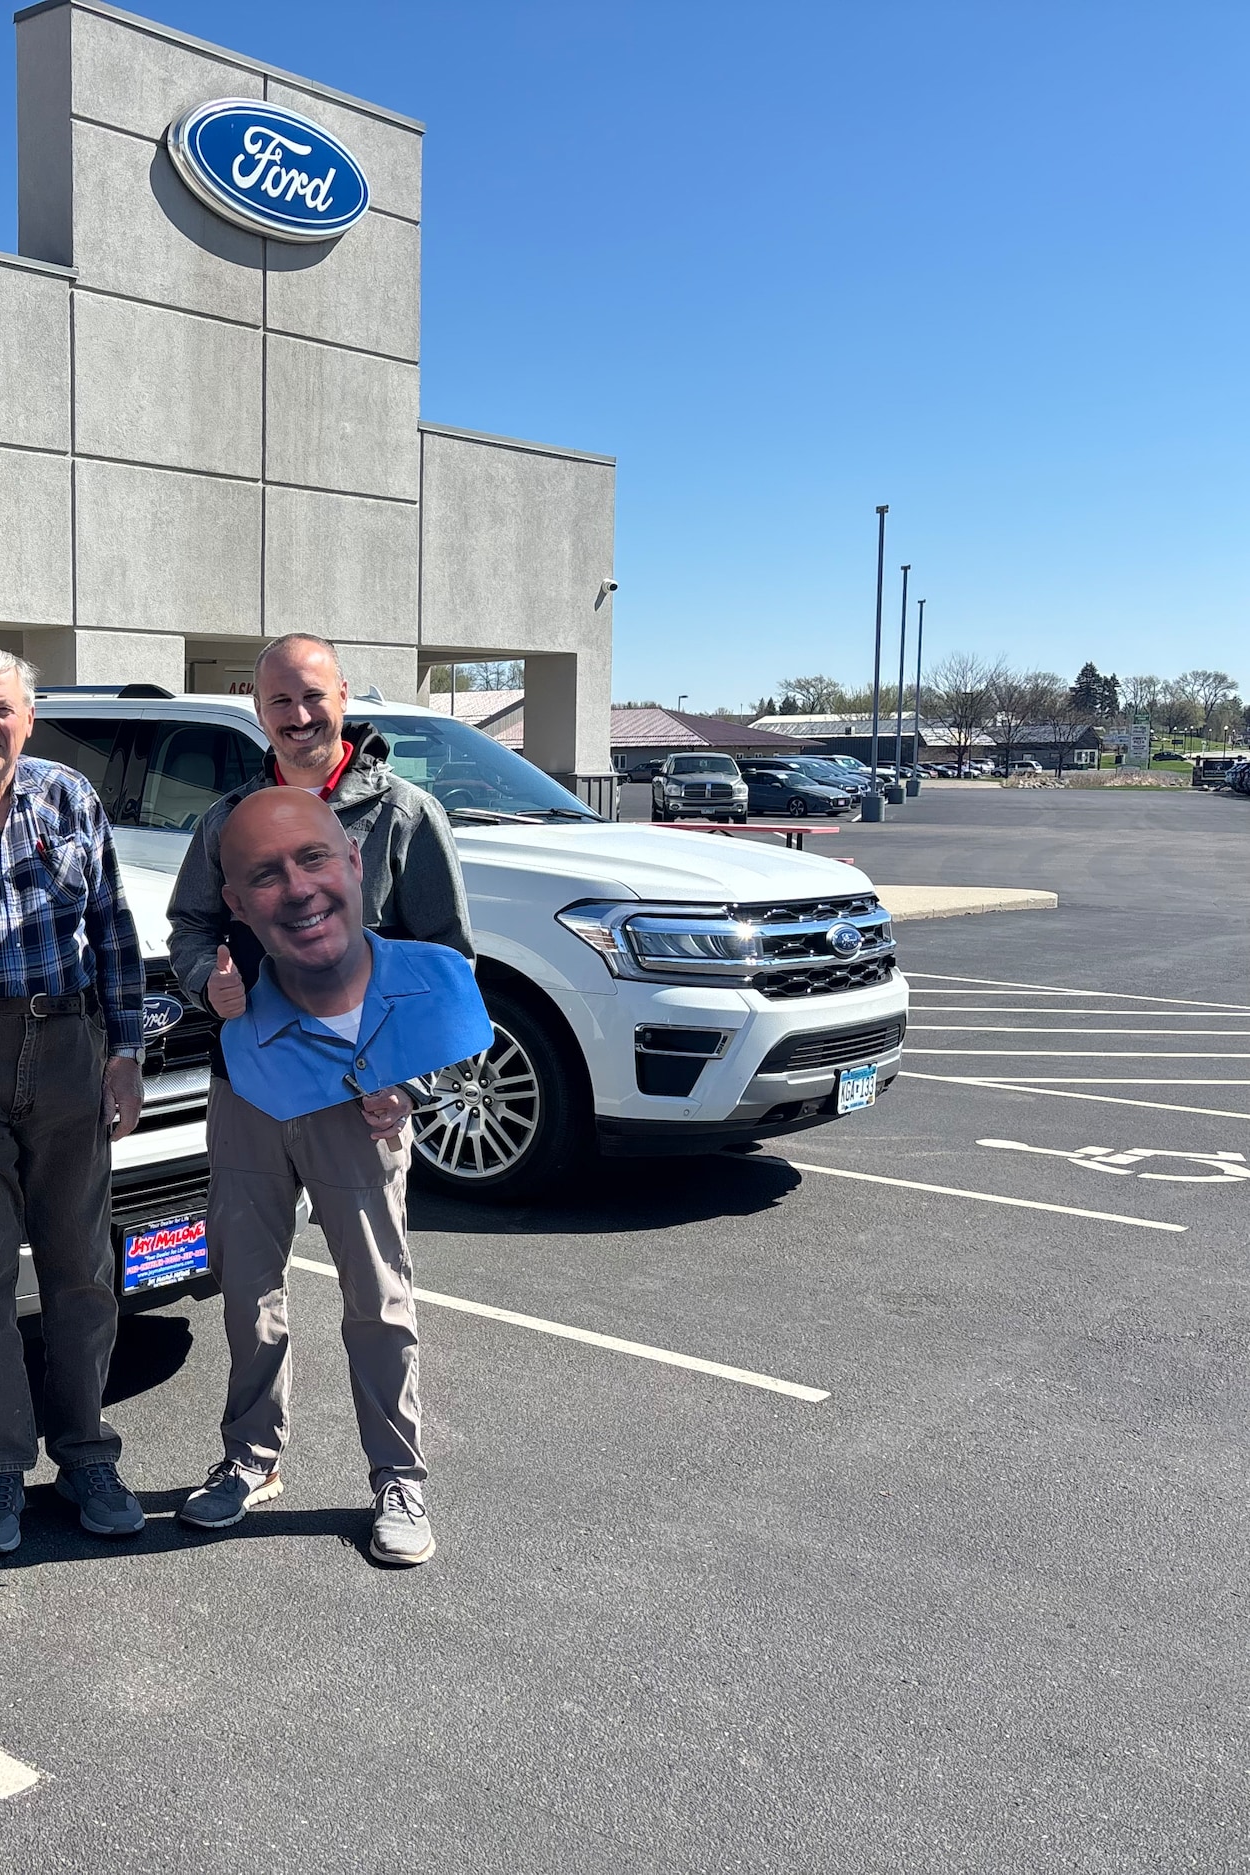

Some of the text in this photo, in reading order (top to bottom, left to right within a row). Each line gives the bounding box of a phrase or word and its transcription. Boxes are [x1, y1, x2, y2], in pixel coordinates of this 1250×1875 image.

[232, 126, 337, 213] Ford
[129, 1220, 206, 1257] JAY MALONE
